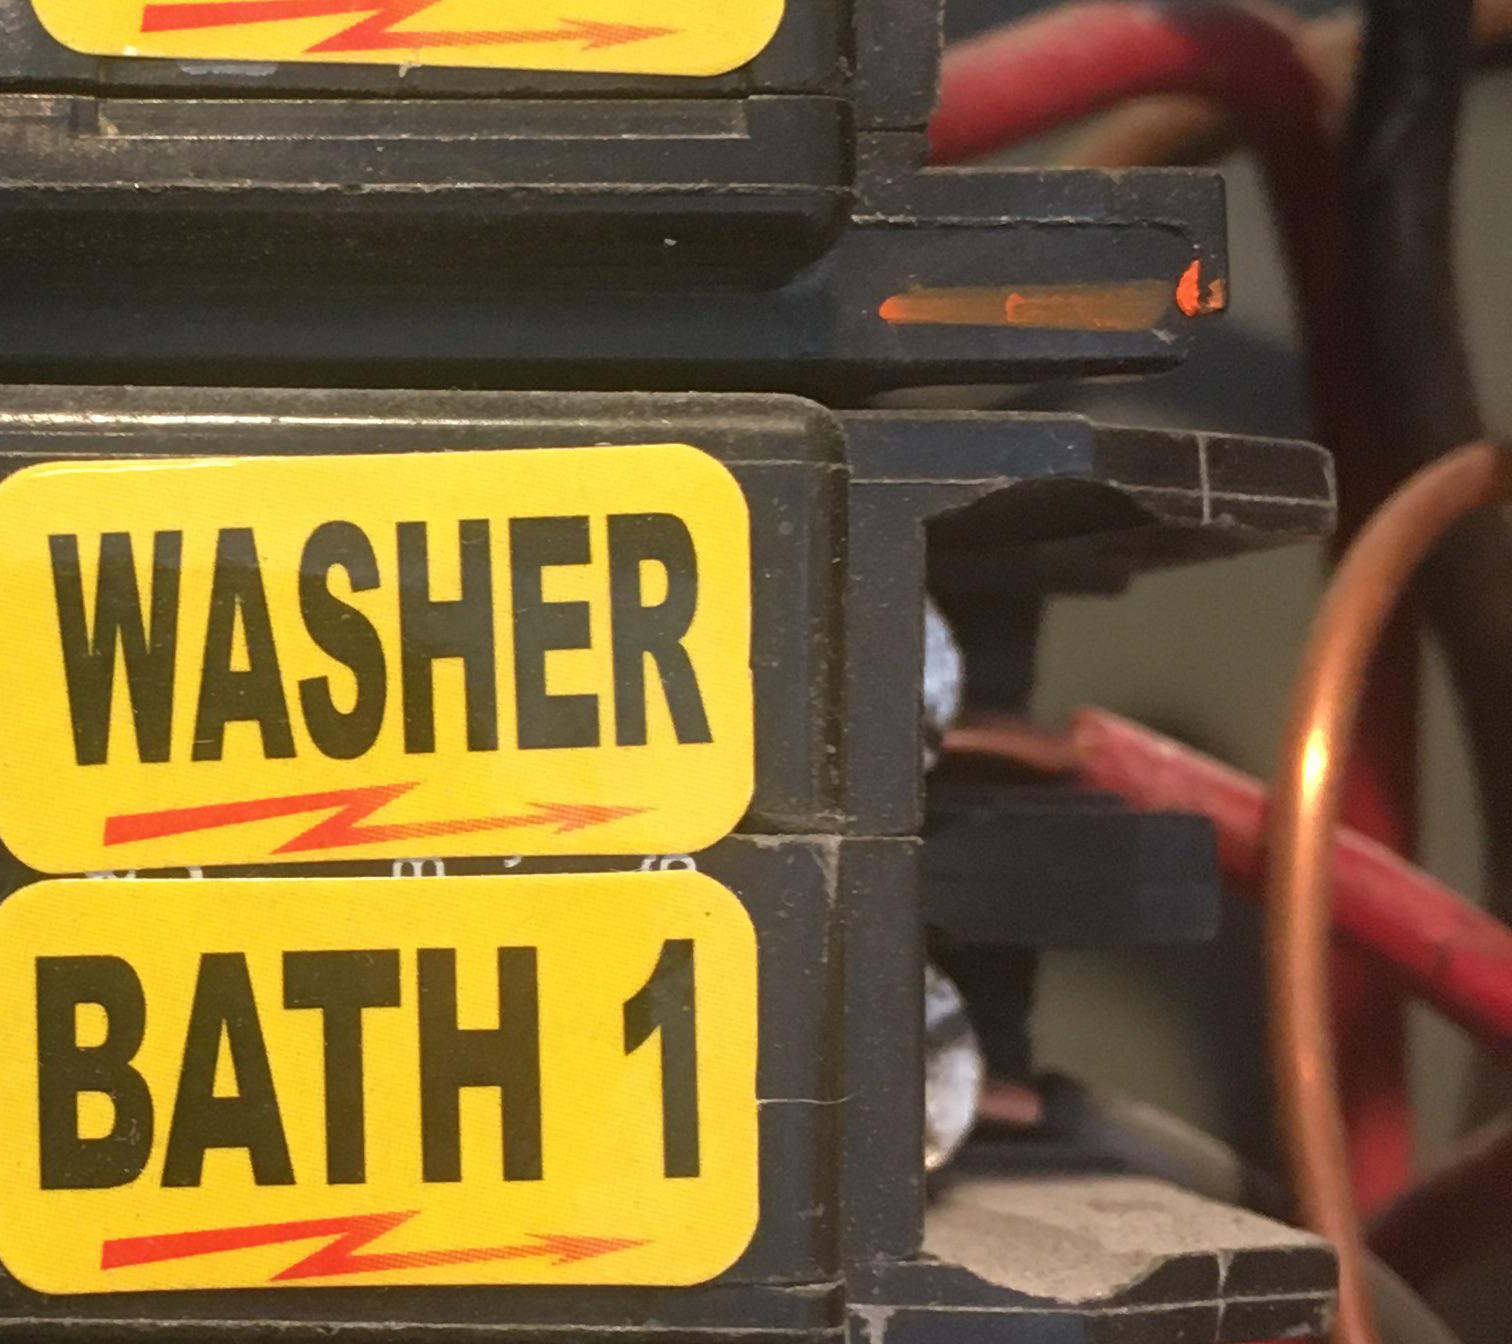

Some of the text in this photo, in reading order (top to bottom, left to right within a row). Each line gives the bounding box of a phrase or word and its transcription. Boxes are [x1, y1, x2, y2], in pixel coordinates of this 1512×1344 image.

[48, 510, 714, 767] WASHER
[35, 938, 702, 1192] BATH 1
